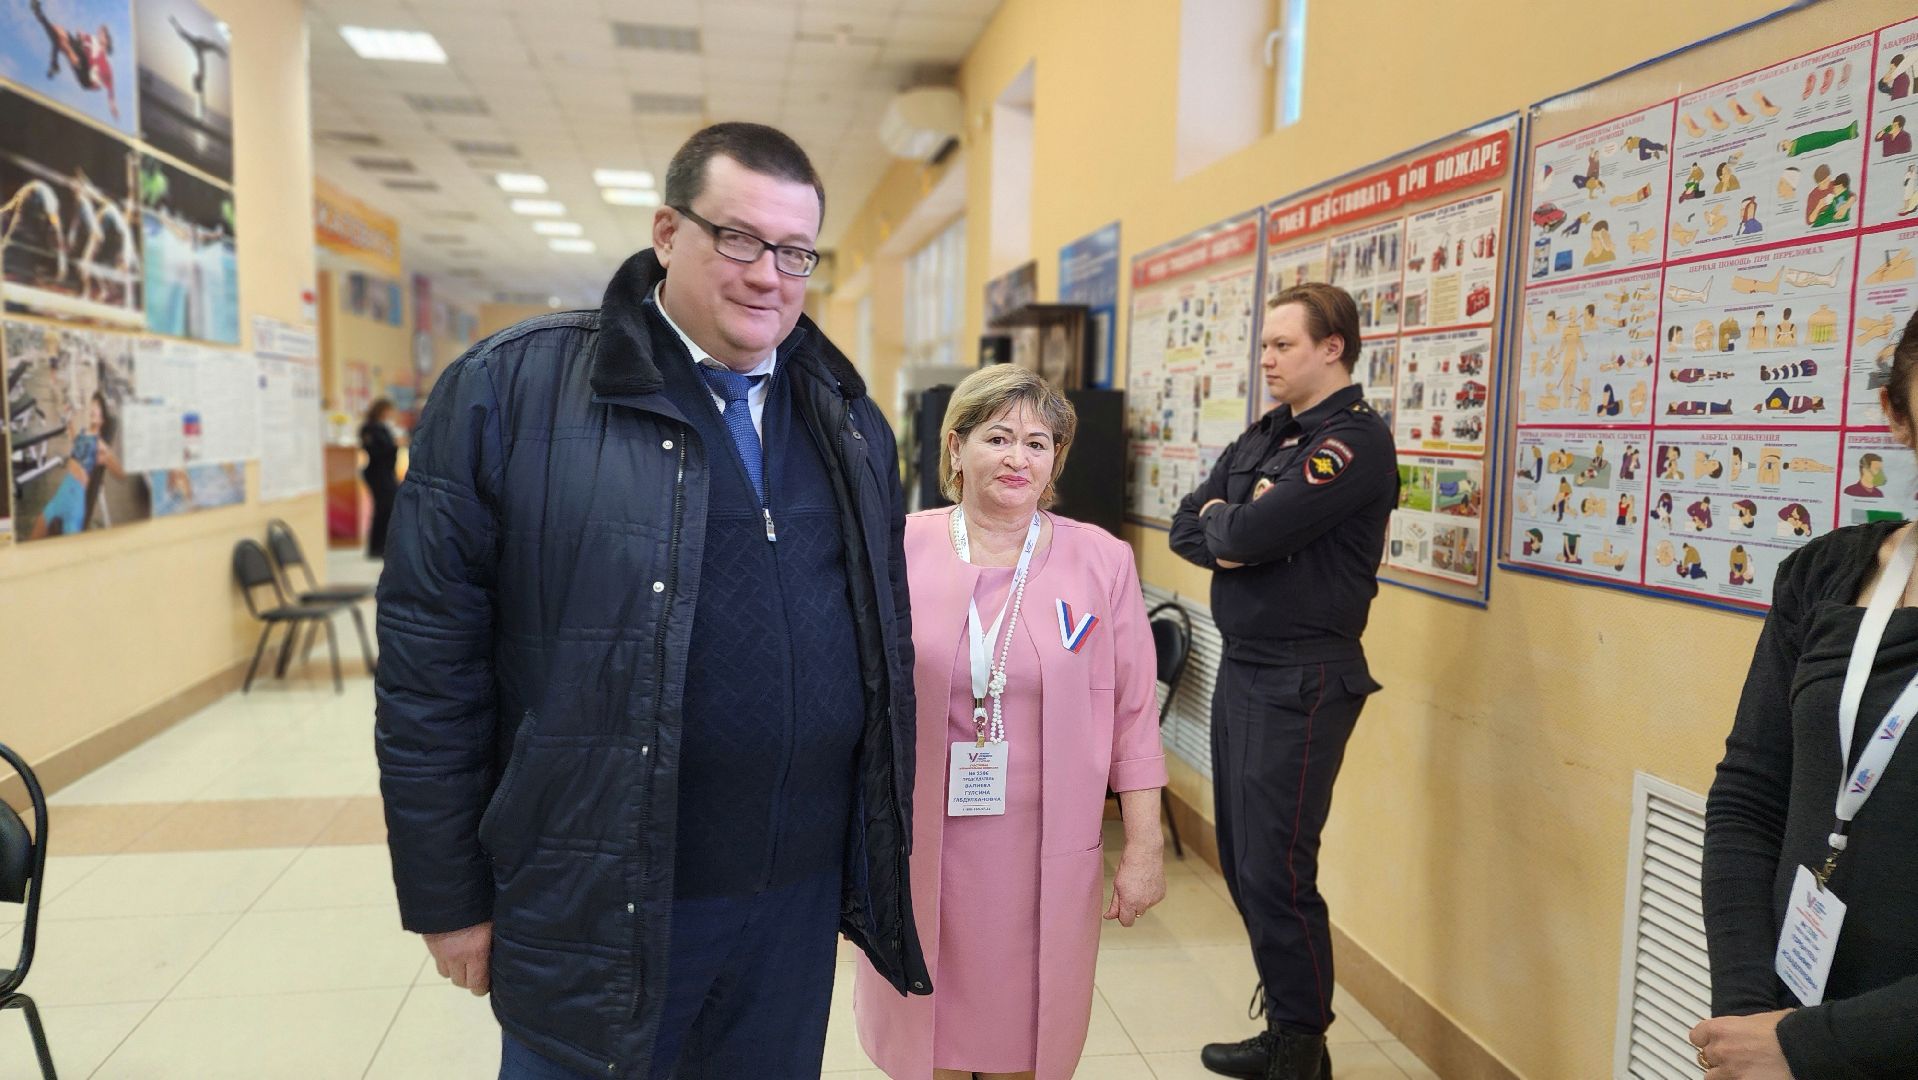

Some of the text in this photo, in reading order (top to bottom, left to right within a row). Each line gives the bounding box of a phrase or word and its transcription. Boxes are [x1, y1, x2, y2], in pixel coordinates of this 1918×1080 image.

[1310, 180, 1392, 228] ДЕЙСТВОВАТЬ
[1398, 164, 1427, 196] ПРИ
[1434, 140, 1503, 184] ПОЖАРЕ
[1753, 255, 1770, 263] ПРИ
[1772, 246, 1825, 260] ПЕРЕЛОМАХ
[1700, 433, 1781, 442] АЗБУКА ОЖИВЛЕНИЯ
